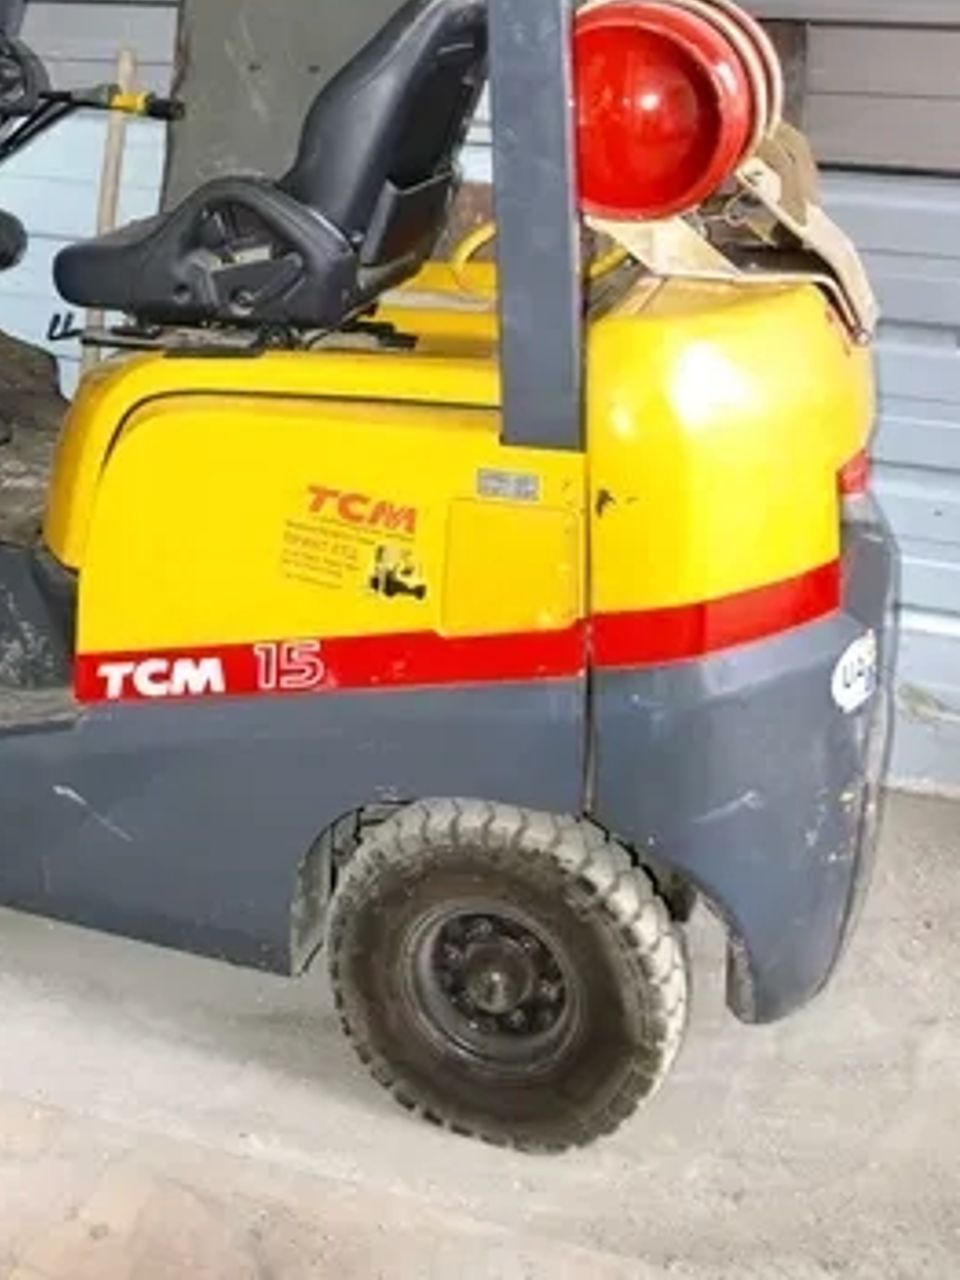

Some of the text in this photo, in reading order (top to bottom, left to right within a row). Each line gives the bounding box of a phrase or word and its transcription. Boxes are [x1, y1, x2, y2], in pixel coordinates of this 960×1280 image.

[308, 485, 416, 535] TCM
[97, 638, 325, 699] TCM 15
